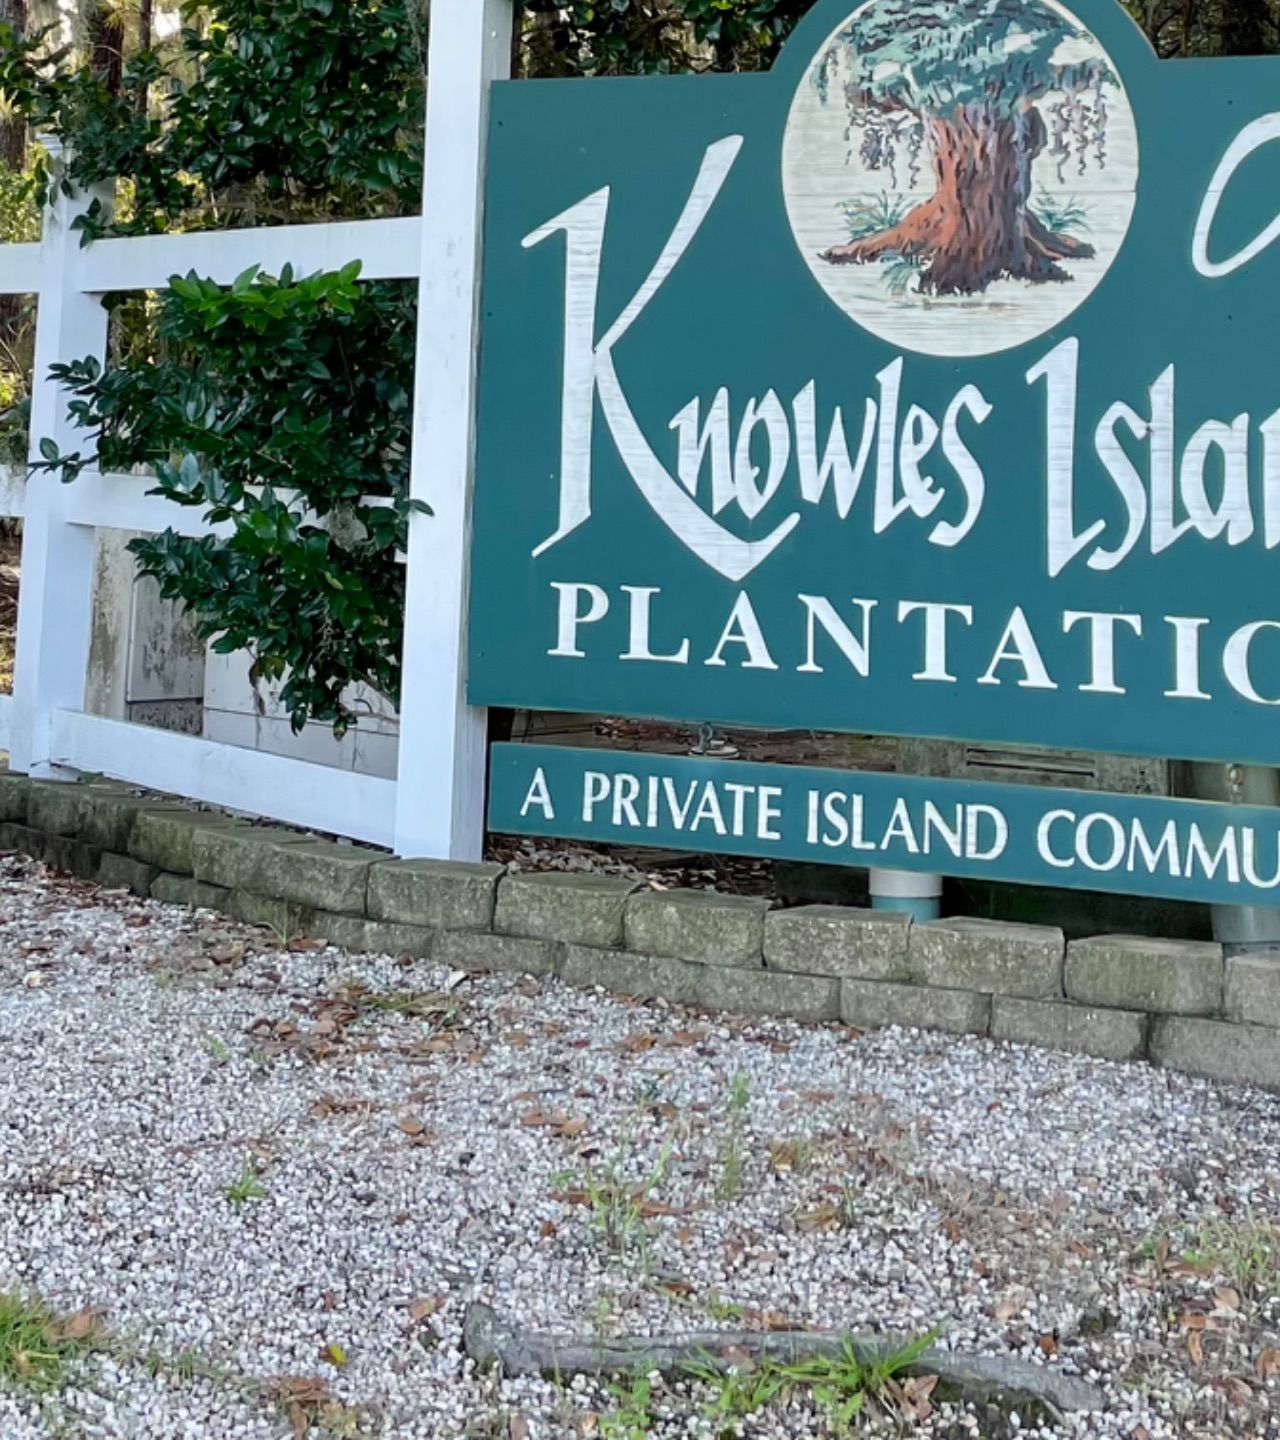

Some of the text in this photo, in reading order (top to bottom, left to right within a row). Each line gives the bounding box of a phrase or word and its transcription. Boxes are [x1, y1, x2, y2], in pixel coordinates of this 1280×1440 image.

[521, 135, 993, 580] Knowles
[520, 768, 557, 820] A
[582, 773, 782, 841] PRIVATE
[807, 794, 1009, 862] ISLAND
